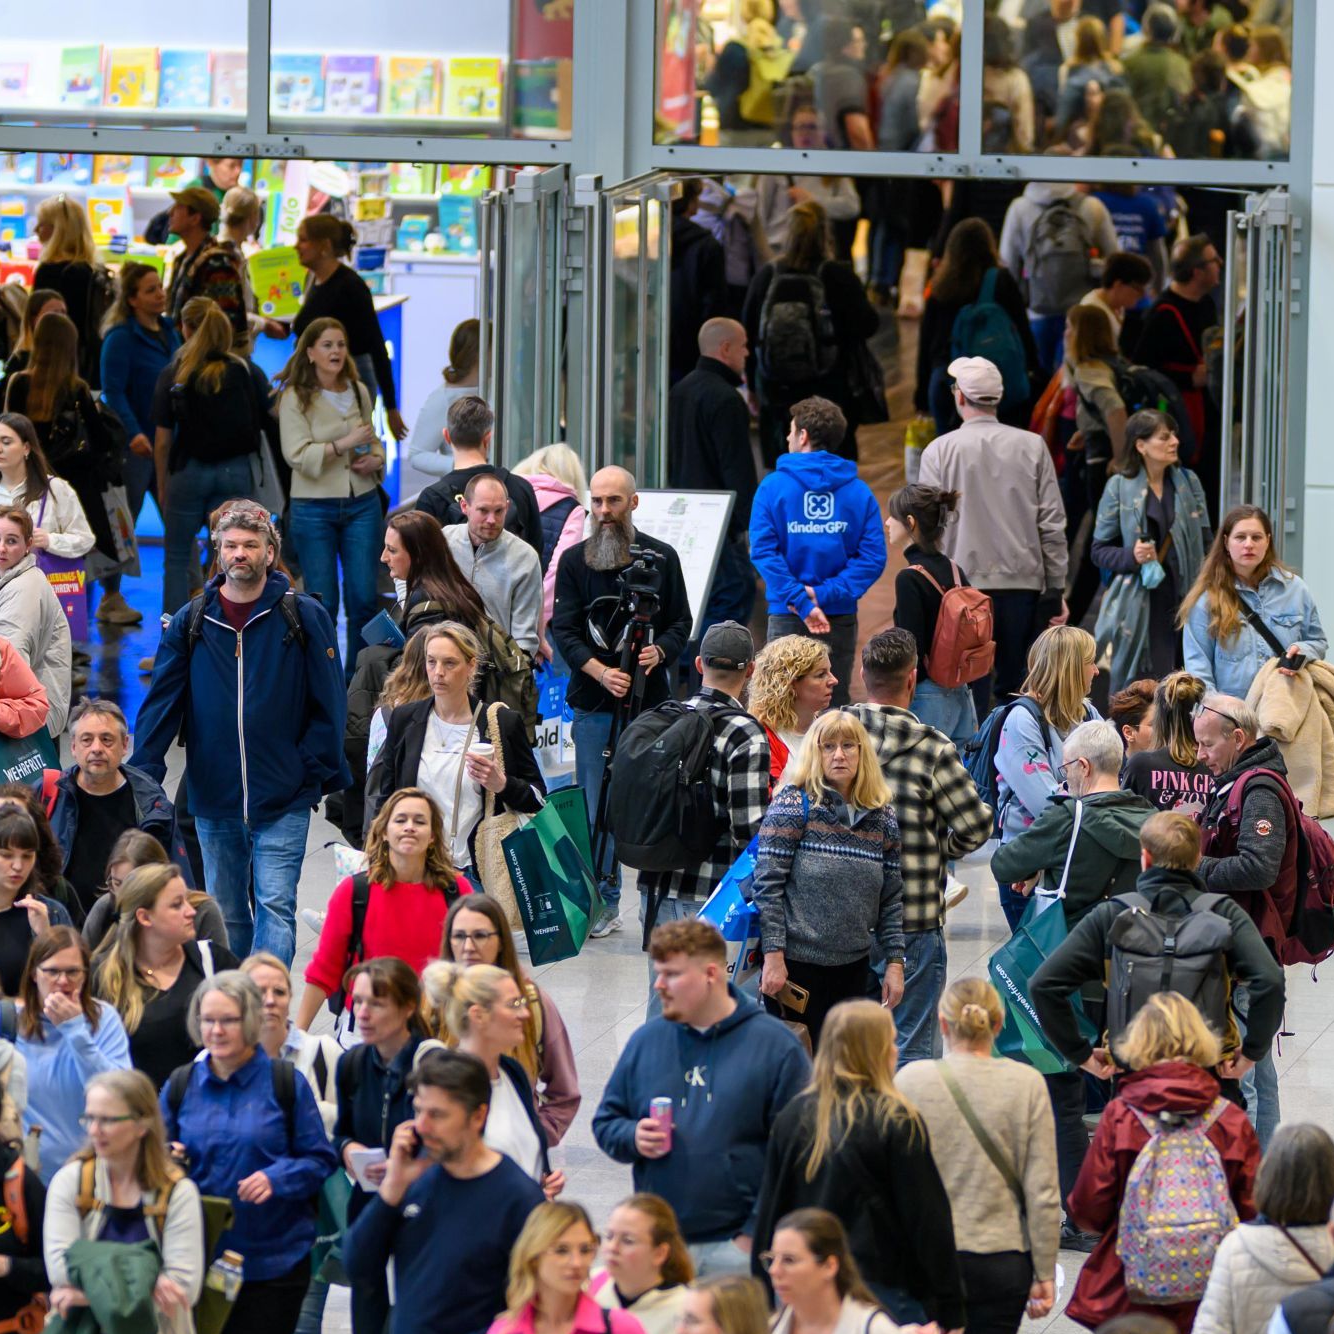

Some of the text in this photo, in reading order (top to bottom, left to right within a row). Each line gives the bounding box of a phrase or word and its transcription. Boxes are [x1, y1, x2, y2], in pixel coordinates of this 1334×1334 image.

[787, 521, 848, 534] KinderGPT
[3, 754, 47, 784] WEHRFRITZ
[1151, 770, 1214, 794] PINK GI
[509, 848, 535, 922] www.wehrfritz.com
